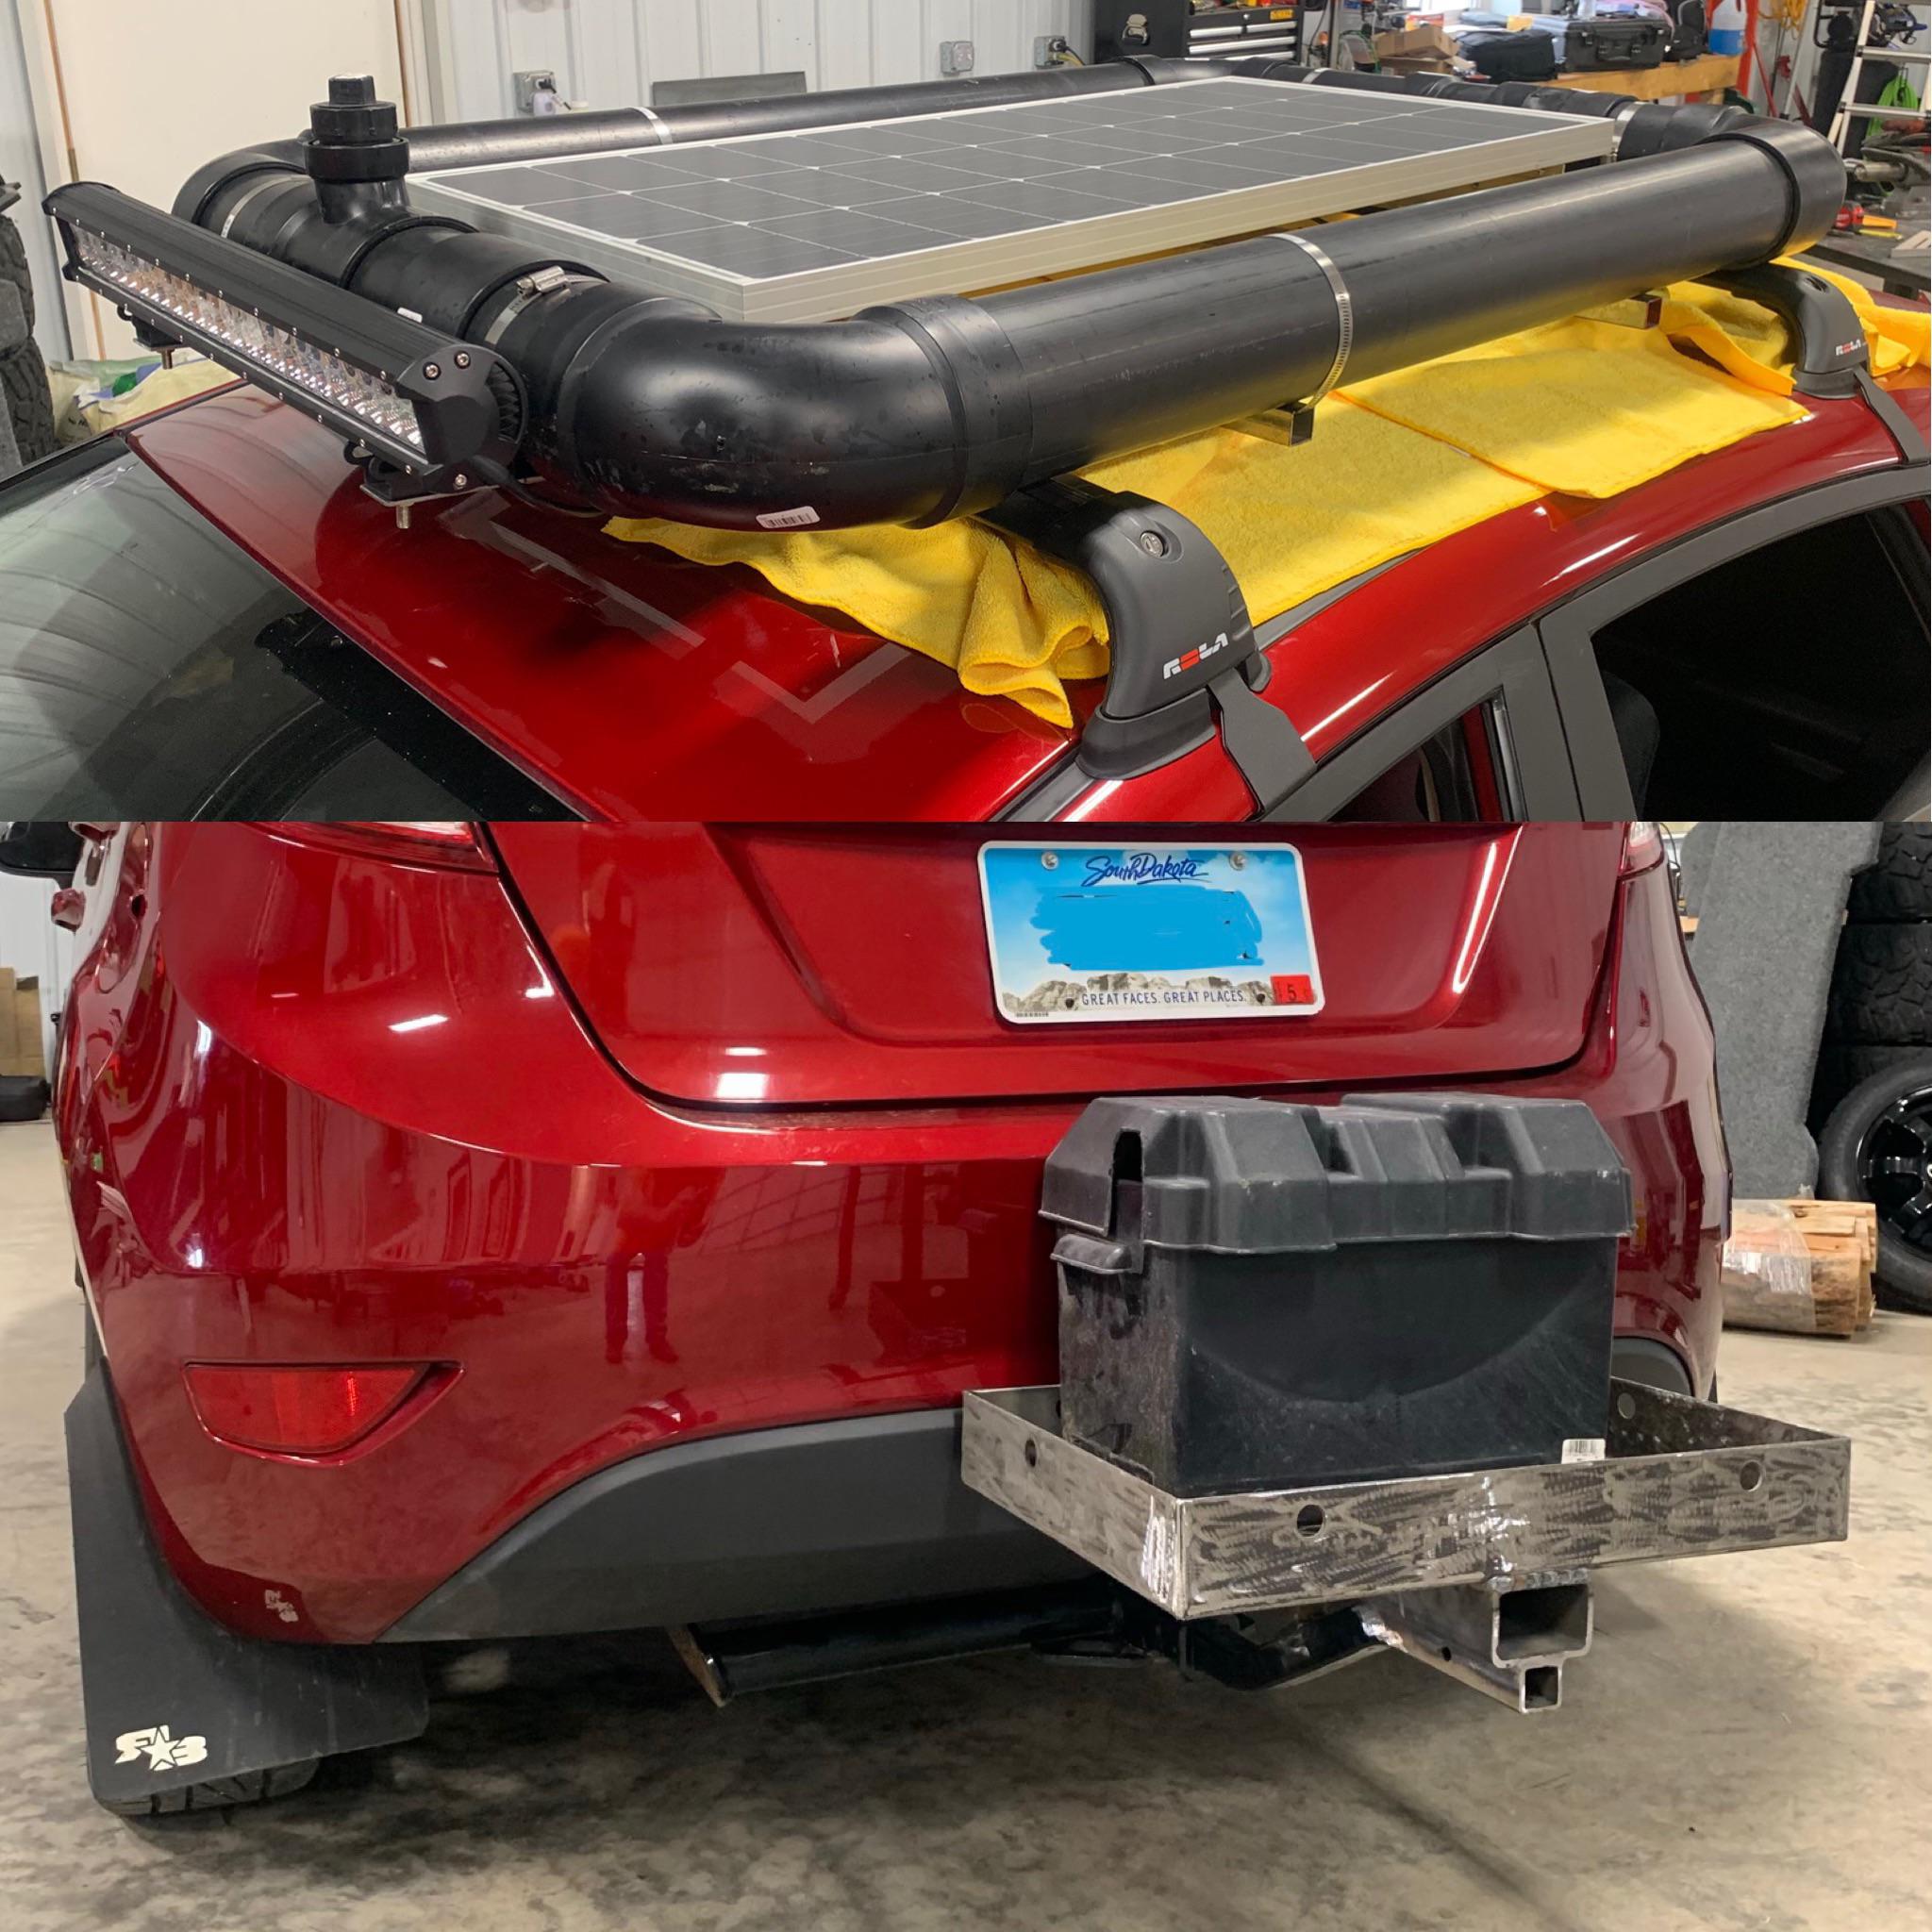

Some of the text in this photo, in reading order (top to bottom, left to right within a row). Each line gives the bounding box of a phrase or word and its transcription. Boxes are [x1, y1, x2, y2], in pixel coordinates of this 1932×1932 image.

[1081, 992, 1120, 1007] GREAT
[1123, 992, 1161, 1005] FACES.
[1163, 991, 1201, 1004] GREAT
[1287, 983, 1298, 1003] 5
